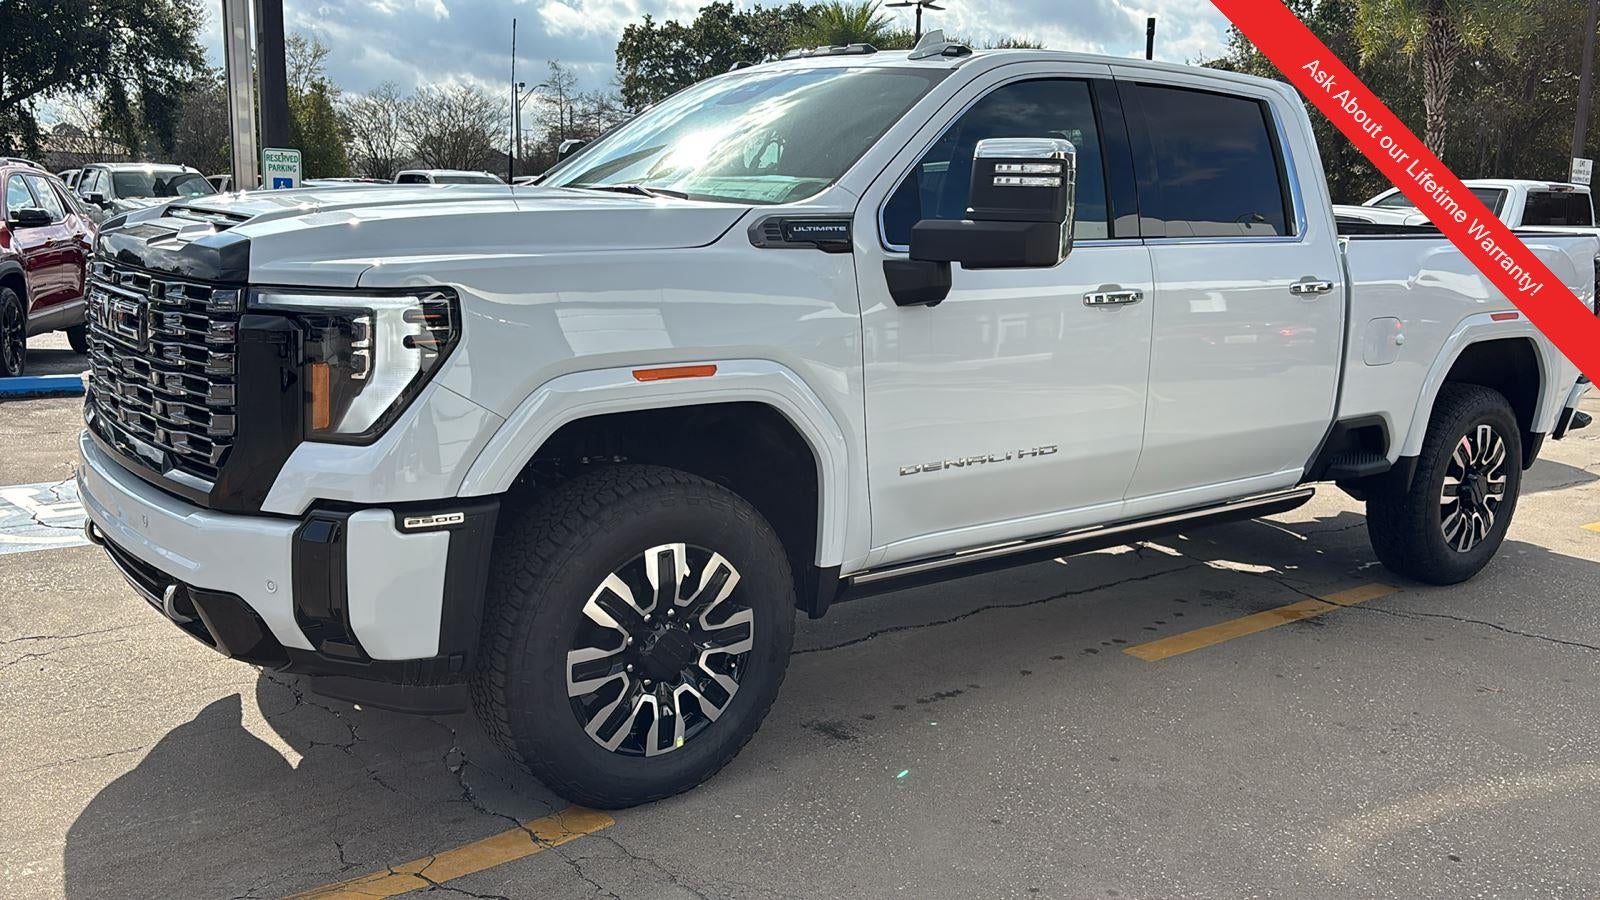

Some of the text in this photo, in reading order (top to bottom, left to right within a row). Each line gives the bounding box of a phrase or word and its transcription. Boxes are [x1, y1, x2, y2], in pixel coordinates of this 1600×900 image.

[265, 153, 299, 163] RESERVED
[268, 163, 297, 173] PARKING
[899, 445, 1058, 476] DENALI HD
[406, 514, 462, 526] 2500
